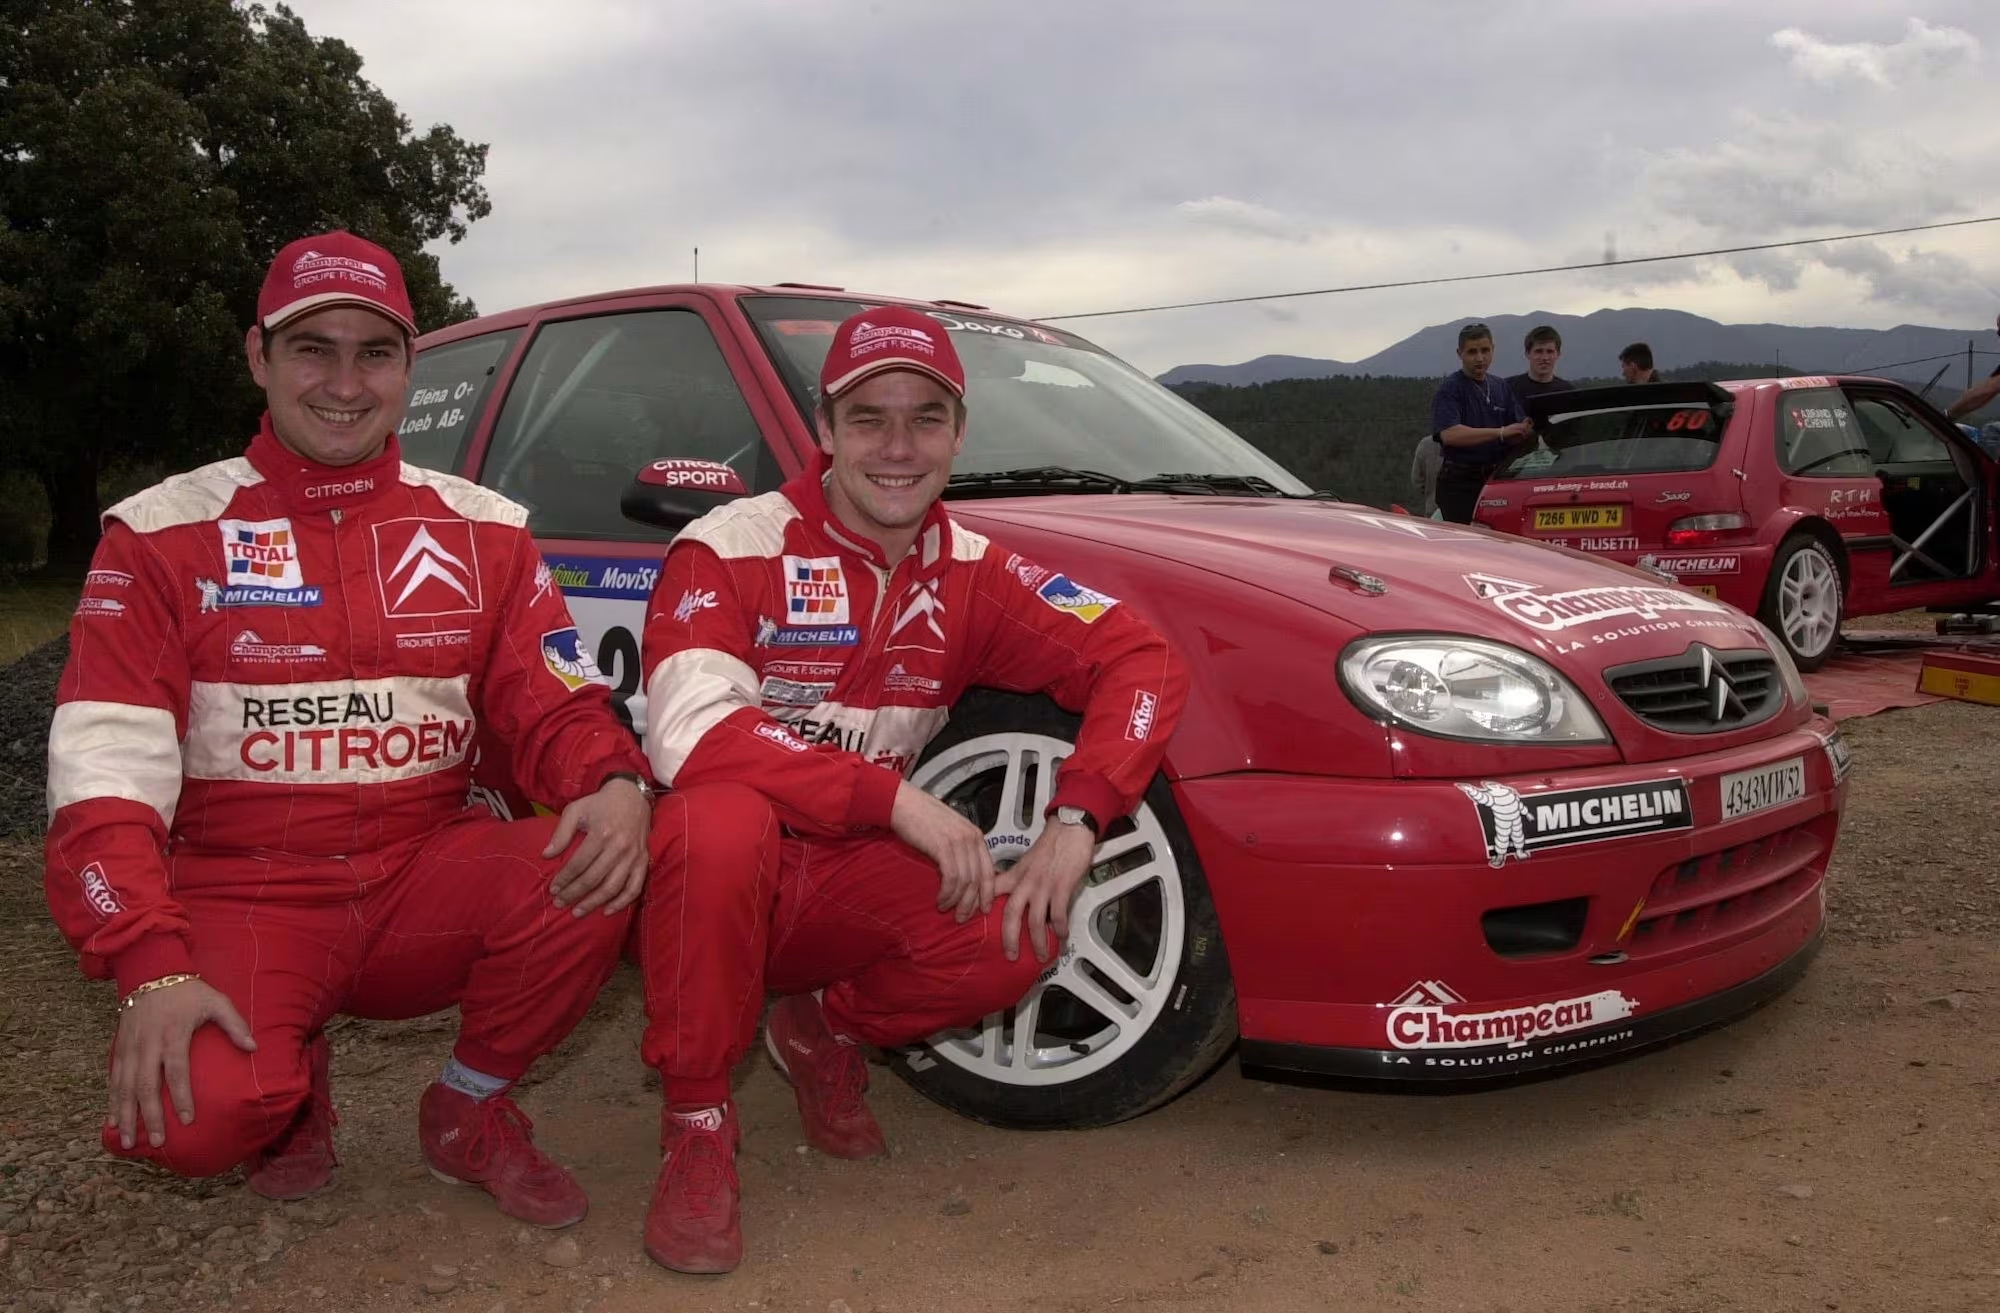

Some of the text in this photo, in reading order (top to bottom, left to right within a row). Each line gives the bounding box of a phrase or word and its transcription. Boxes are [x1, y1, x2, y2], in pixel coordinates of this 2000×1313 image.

[925, 311, 1025, 339] Saxo
[409, 388, 449, 408] Elena
[398, 413, 433, 435] Loeb
[1666, 410, 1709, 432] 60
[304, 478, 374, 499] CITROËN
[666, 471, 728, 486] SPORT
[1655, 491, 1691, 503] Saxo
[1538, 510, 1618, 526] 7266 WWD 74
[228, 543, 294, 562] TOTAL
[1543, 538, 1639, 551] AGE FILISETTI
[1660, 558, 1736, 571] MICHELIN
[600, 567, 659, 591] MoviSt
[789, 581, 845, 597] TOTAL
[224, 589, 319, 603] MICHELIN
[1498, 588, 1690, 628] Champeau
[776, 630, 857, 642] MICHELIN
[1557, 642, 1585, 654] LA
[1592, 621, 1681, 644] SOLUTION
[232, 644, 302, 658] Champeau
[243, 691, 393, 728] RESEAU
[240, 713, 473, 772] CITROËN
[1726, 765, 1800, 816] 4343MW52
[1535, 788, 1683, 832] MICHELIN
[1392, 1000, 1594, 1045] Champeau
[1382, 1029, 1634, 1066] LA SOLUTION CHARPENTE
